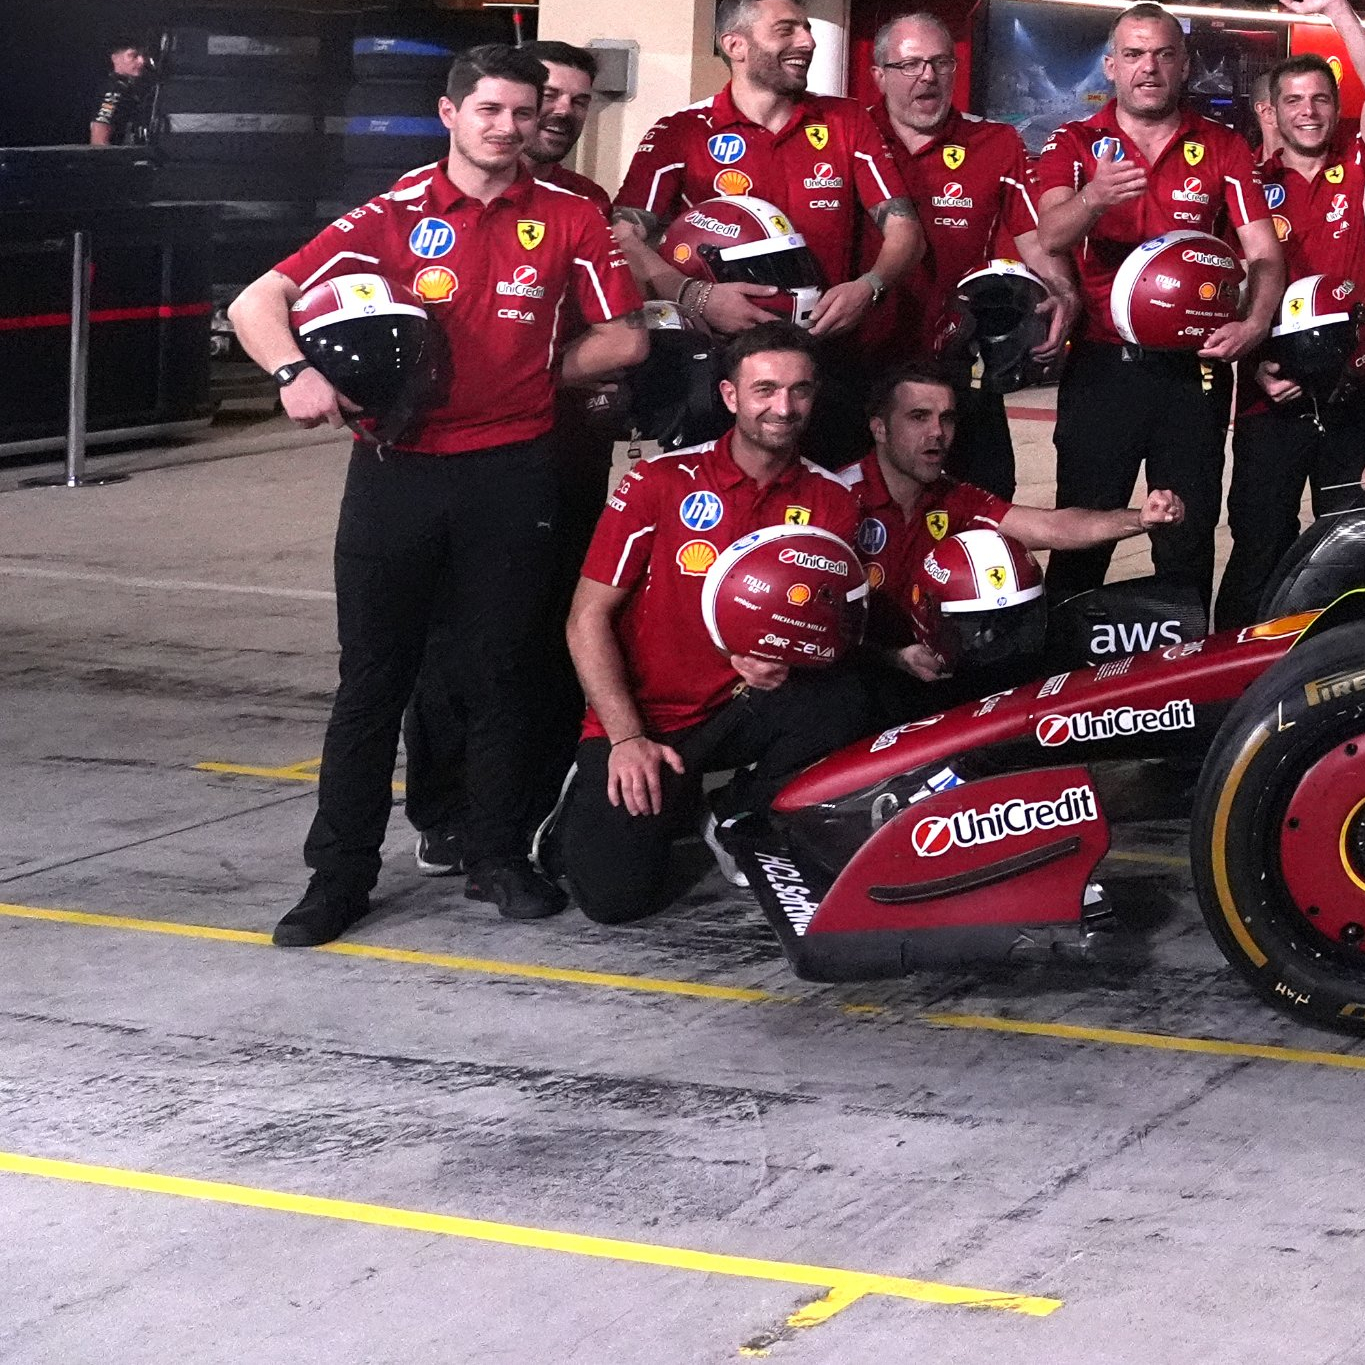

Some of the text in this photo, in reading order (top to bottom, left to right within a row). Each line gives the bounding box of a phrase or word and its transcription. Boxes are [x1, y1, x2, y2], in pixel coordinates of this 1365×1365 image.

[711, 134, 743, 163] hp
[803, 178, 844, 189] UniCredit
[932, 196, 973, 208] UniCredit
[1172, 190, 1210, 204] UniCredit
[693, 215, 741, 239] UniCredit
[413, 218, 451, 257] hp
[1195, 251, 1235, 270] UniCredit
[495, 281, 545, 299] UniCredit
[1185, 309, 1213, 318] RICHARD
[683, 491, 719, 530] hp
[795, 551, 849, 577] UniCredit
[743, 574, 771, 593] ITALIA
[733, 596, 757, 611] ambipar
[771, 613, 828, 633] RICHARD MILLE
[1090, 619, 1183, 655] aws
[1071, 701, 1195, 740] UniCredit
[952, 788, 1096, 846] UniCredit
